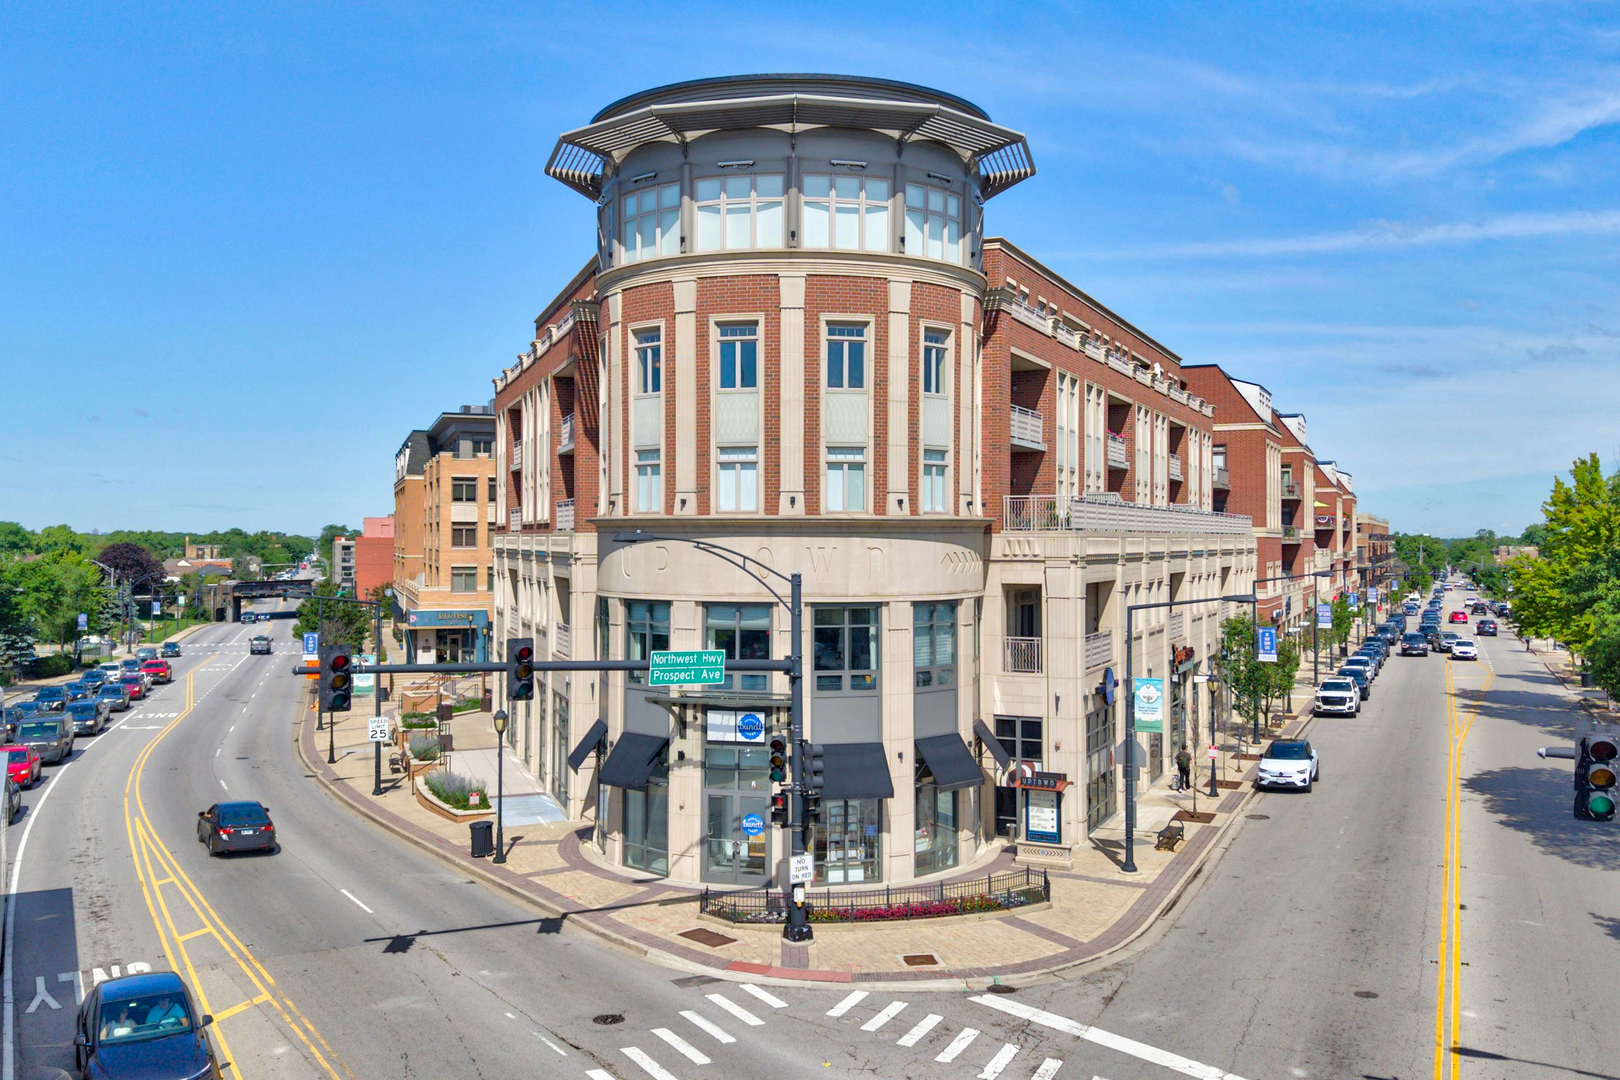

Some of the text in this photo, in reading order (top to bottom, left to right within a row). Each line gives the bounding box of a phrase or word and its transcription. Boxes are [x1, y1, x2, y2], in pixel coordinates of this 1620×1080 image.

[653, 653, 722, 665] Northwest Hwy
[653, 669, 720, 682] Prospect Ave
[370, 730, 387, 739] 25
[742, 819, 763, 828] bundt
